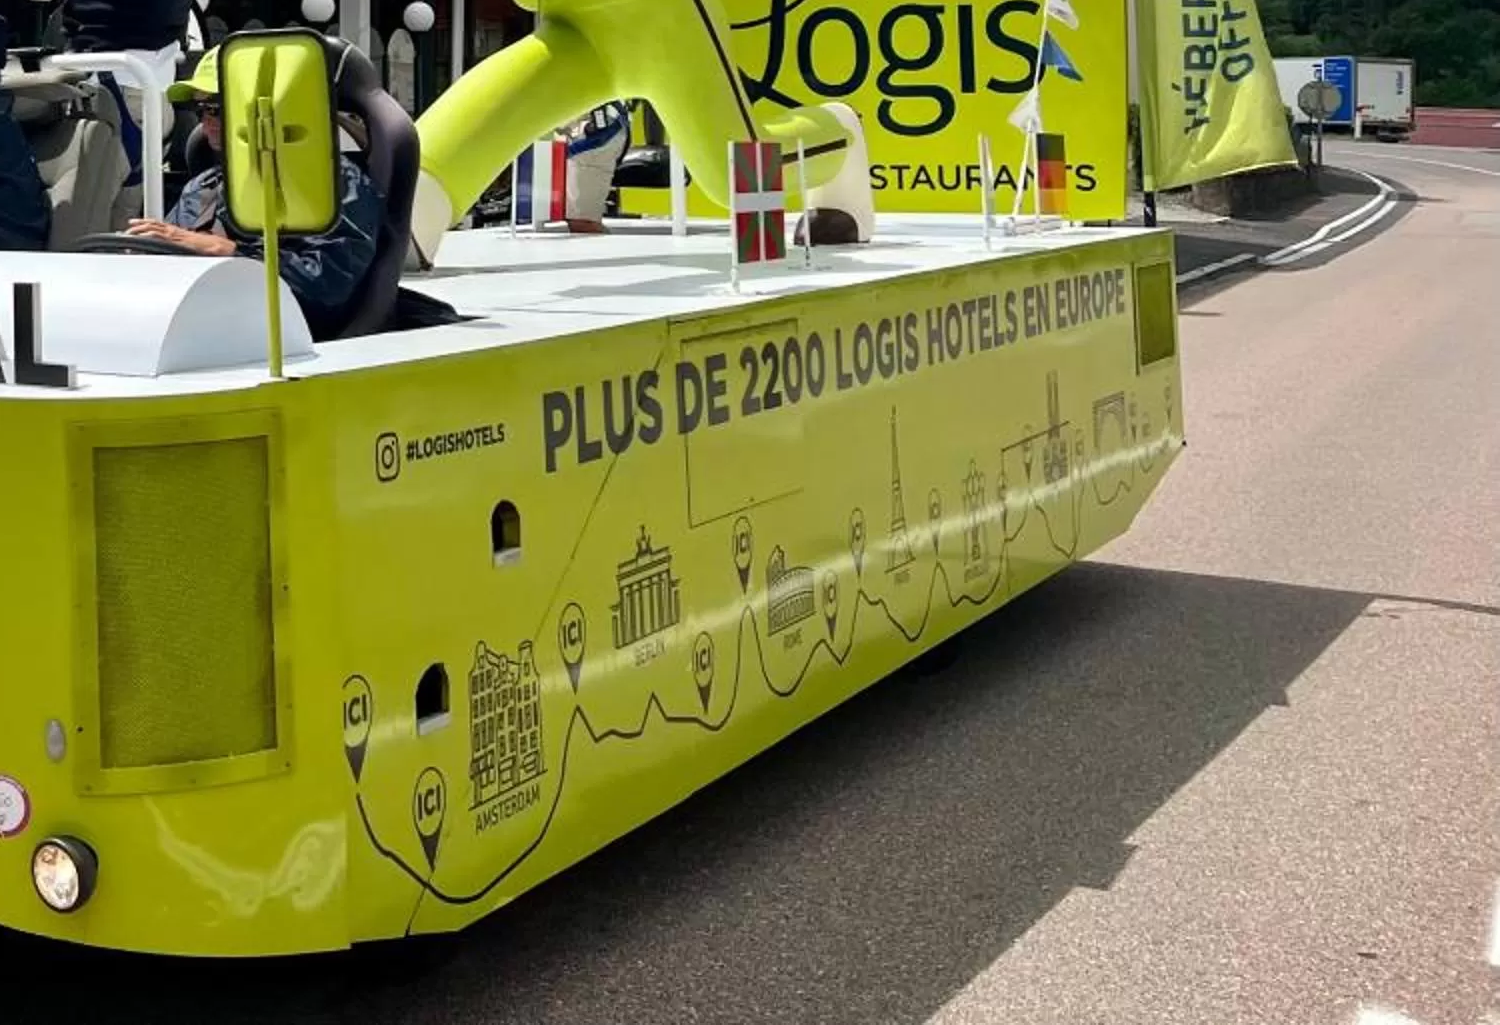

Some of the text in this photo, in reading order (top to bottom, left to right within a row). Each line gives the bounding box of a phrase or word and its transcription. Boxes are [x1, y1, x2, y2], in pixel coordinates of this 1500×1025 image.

[542, 268, 1125, 473] PLUS DE 2200 LOGIS HOTELS EN EUROPE
[406, 423, 506, 461] #LOGISHOTELS
[563, 618, 583, 649] ICI
[343, 694, 368, 730] ICI
[417, 784, 441, 821] ICI
[476, 782, 541, 835] AMSTERDAM
